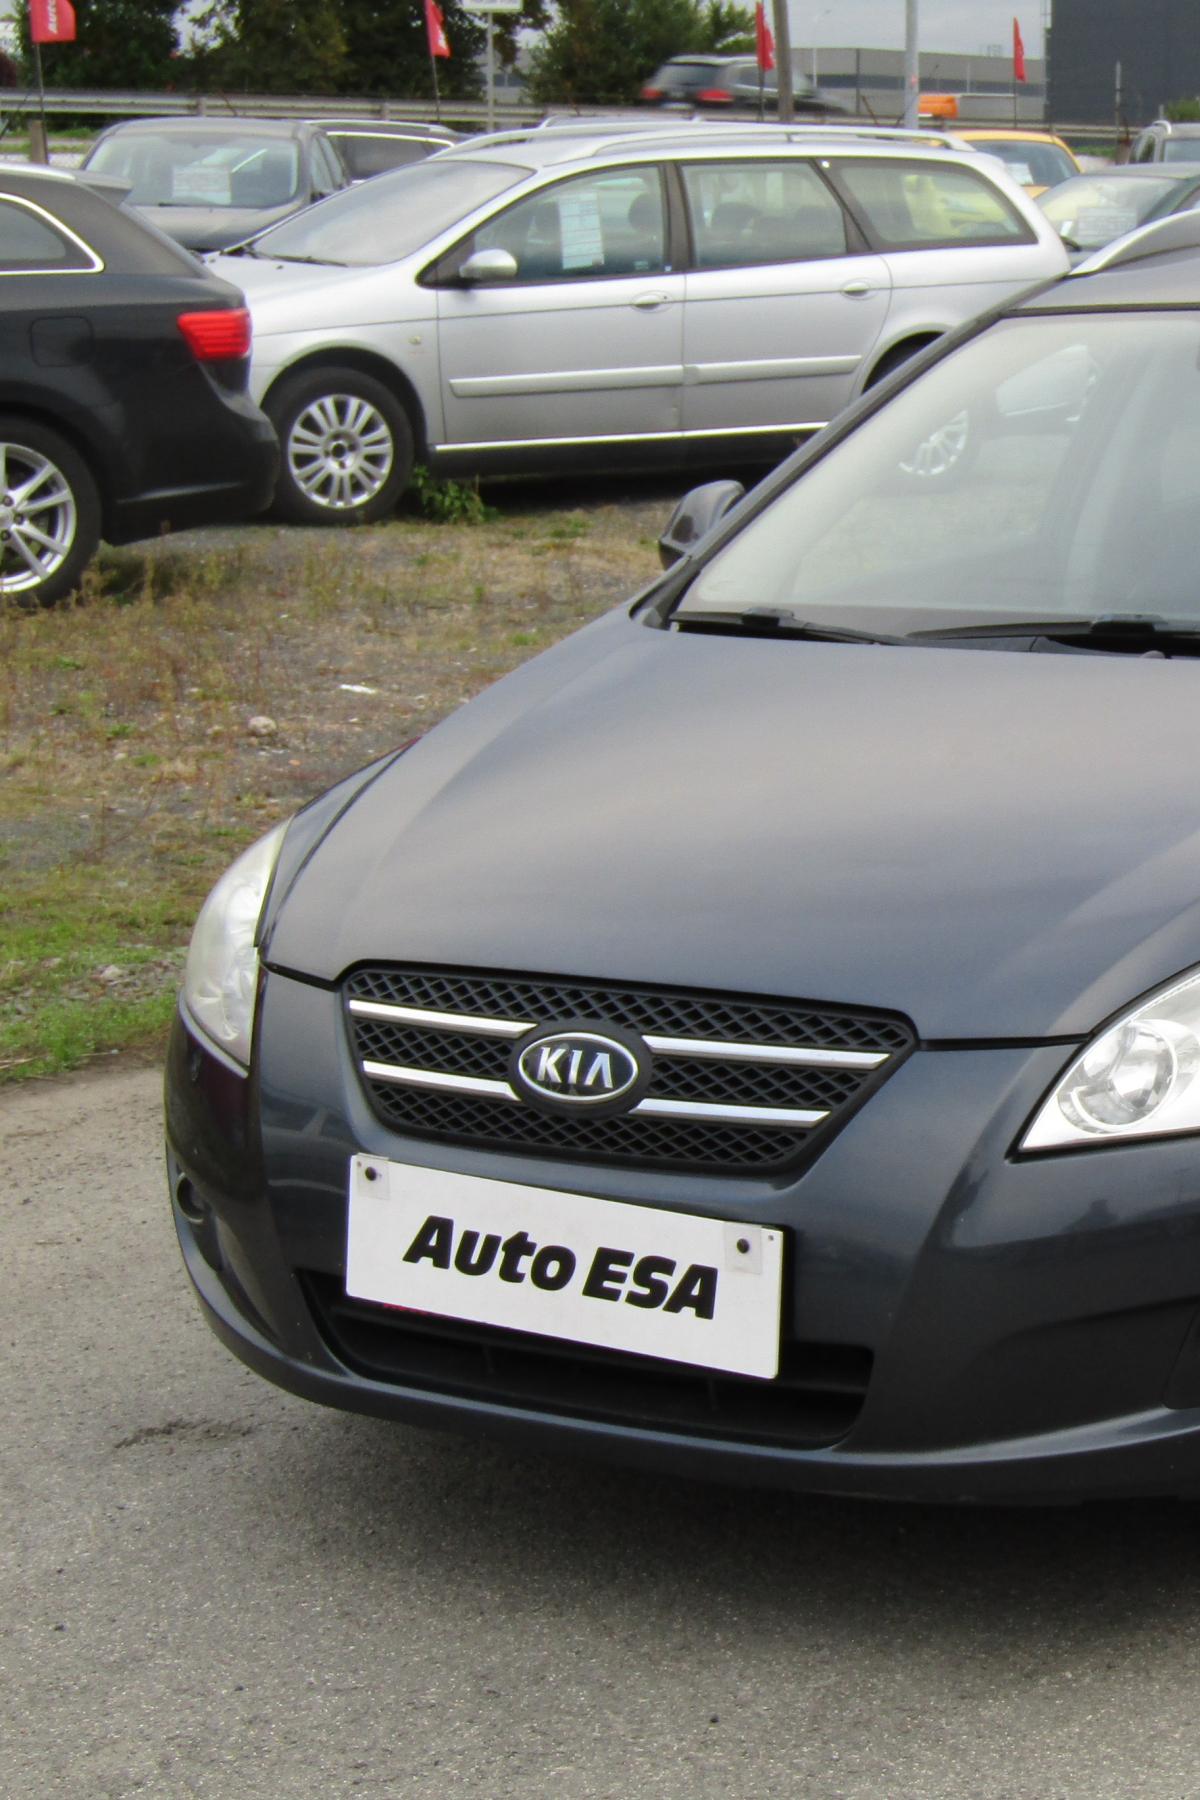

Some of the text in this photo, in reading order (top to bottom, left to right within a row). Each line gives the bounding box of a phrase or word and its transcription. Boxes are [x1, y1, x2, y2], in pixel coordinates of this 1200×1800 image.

[537, 1046, 613, 1089] KIA
[403, 1215, 718, 1320] Auto ESA
